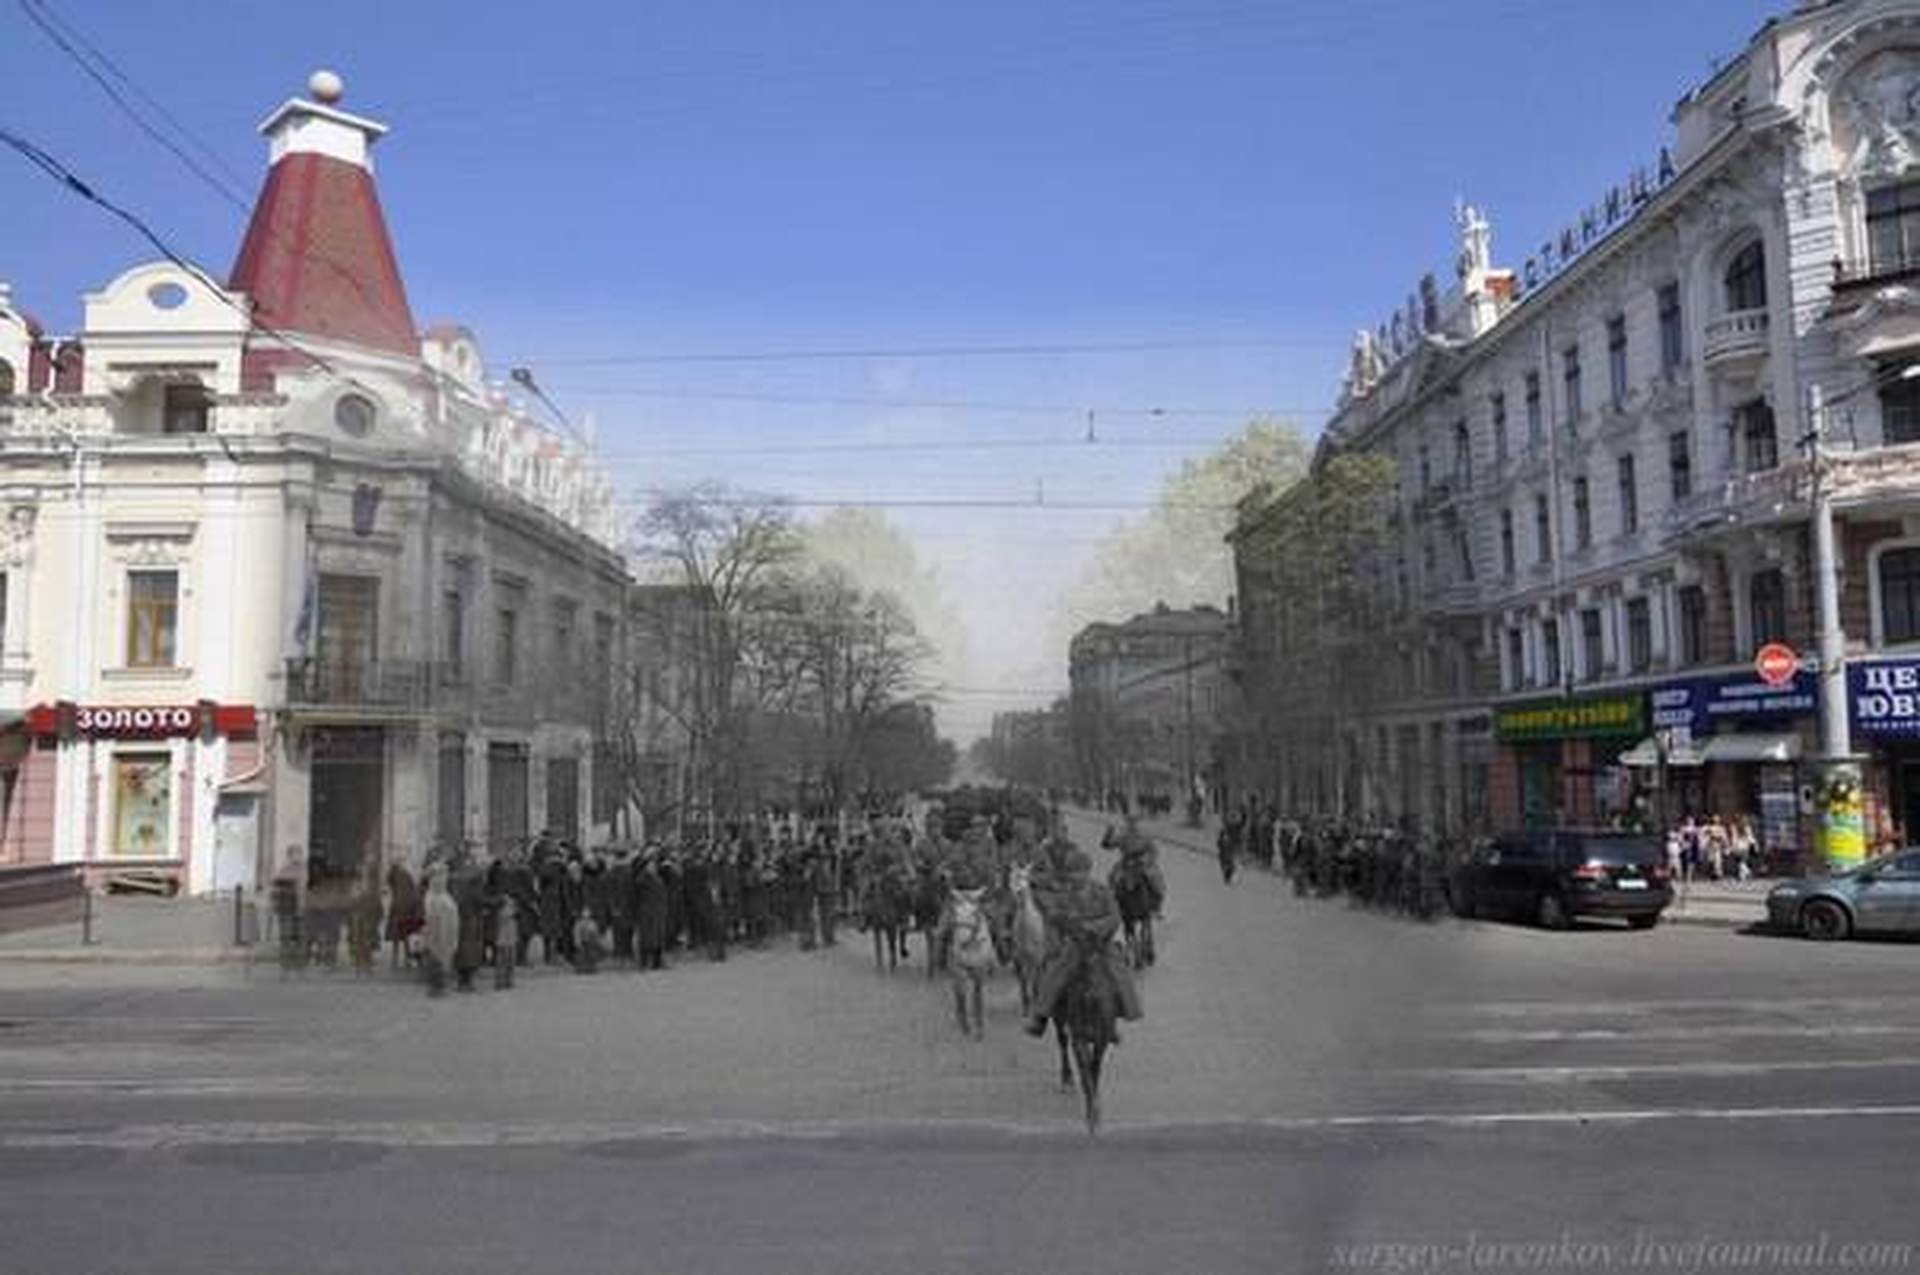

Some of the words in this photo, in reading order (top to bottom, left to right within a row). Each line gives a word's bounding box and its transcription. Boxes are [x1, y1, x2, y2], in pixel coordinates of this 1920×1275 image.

[1522, 146, 1677, 289] СТИНИЦА
[1857, 694, 1920, 717] ЮВ
[76, 708, 192, 729] ЗОЛОТО
